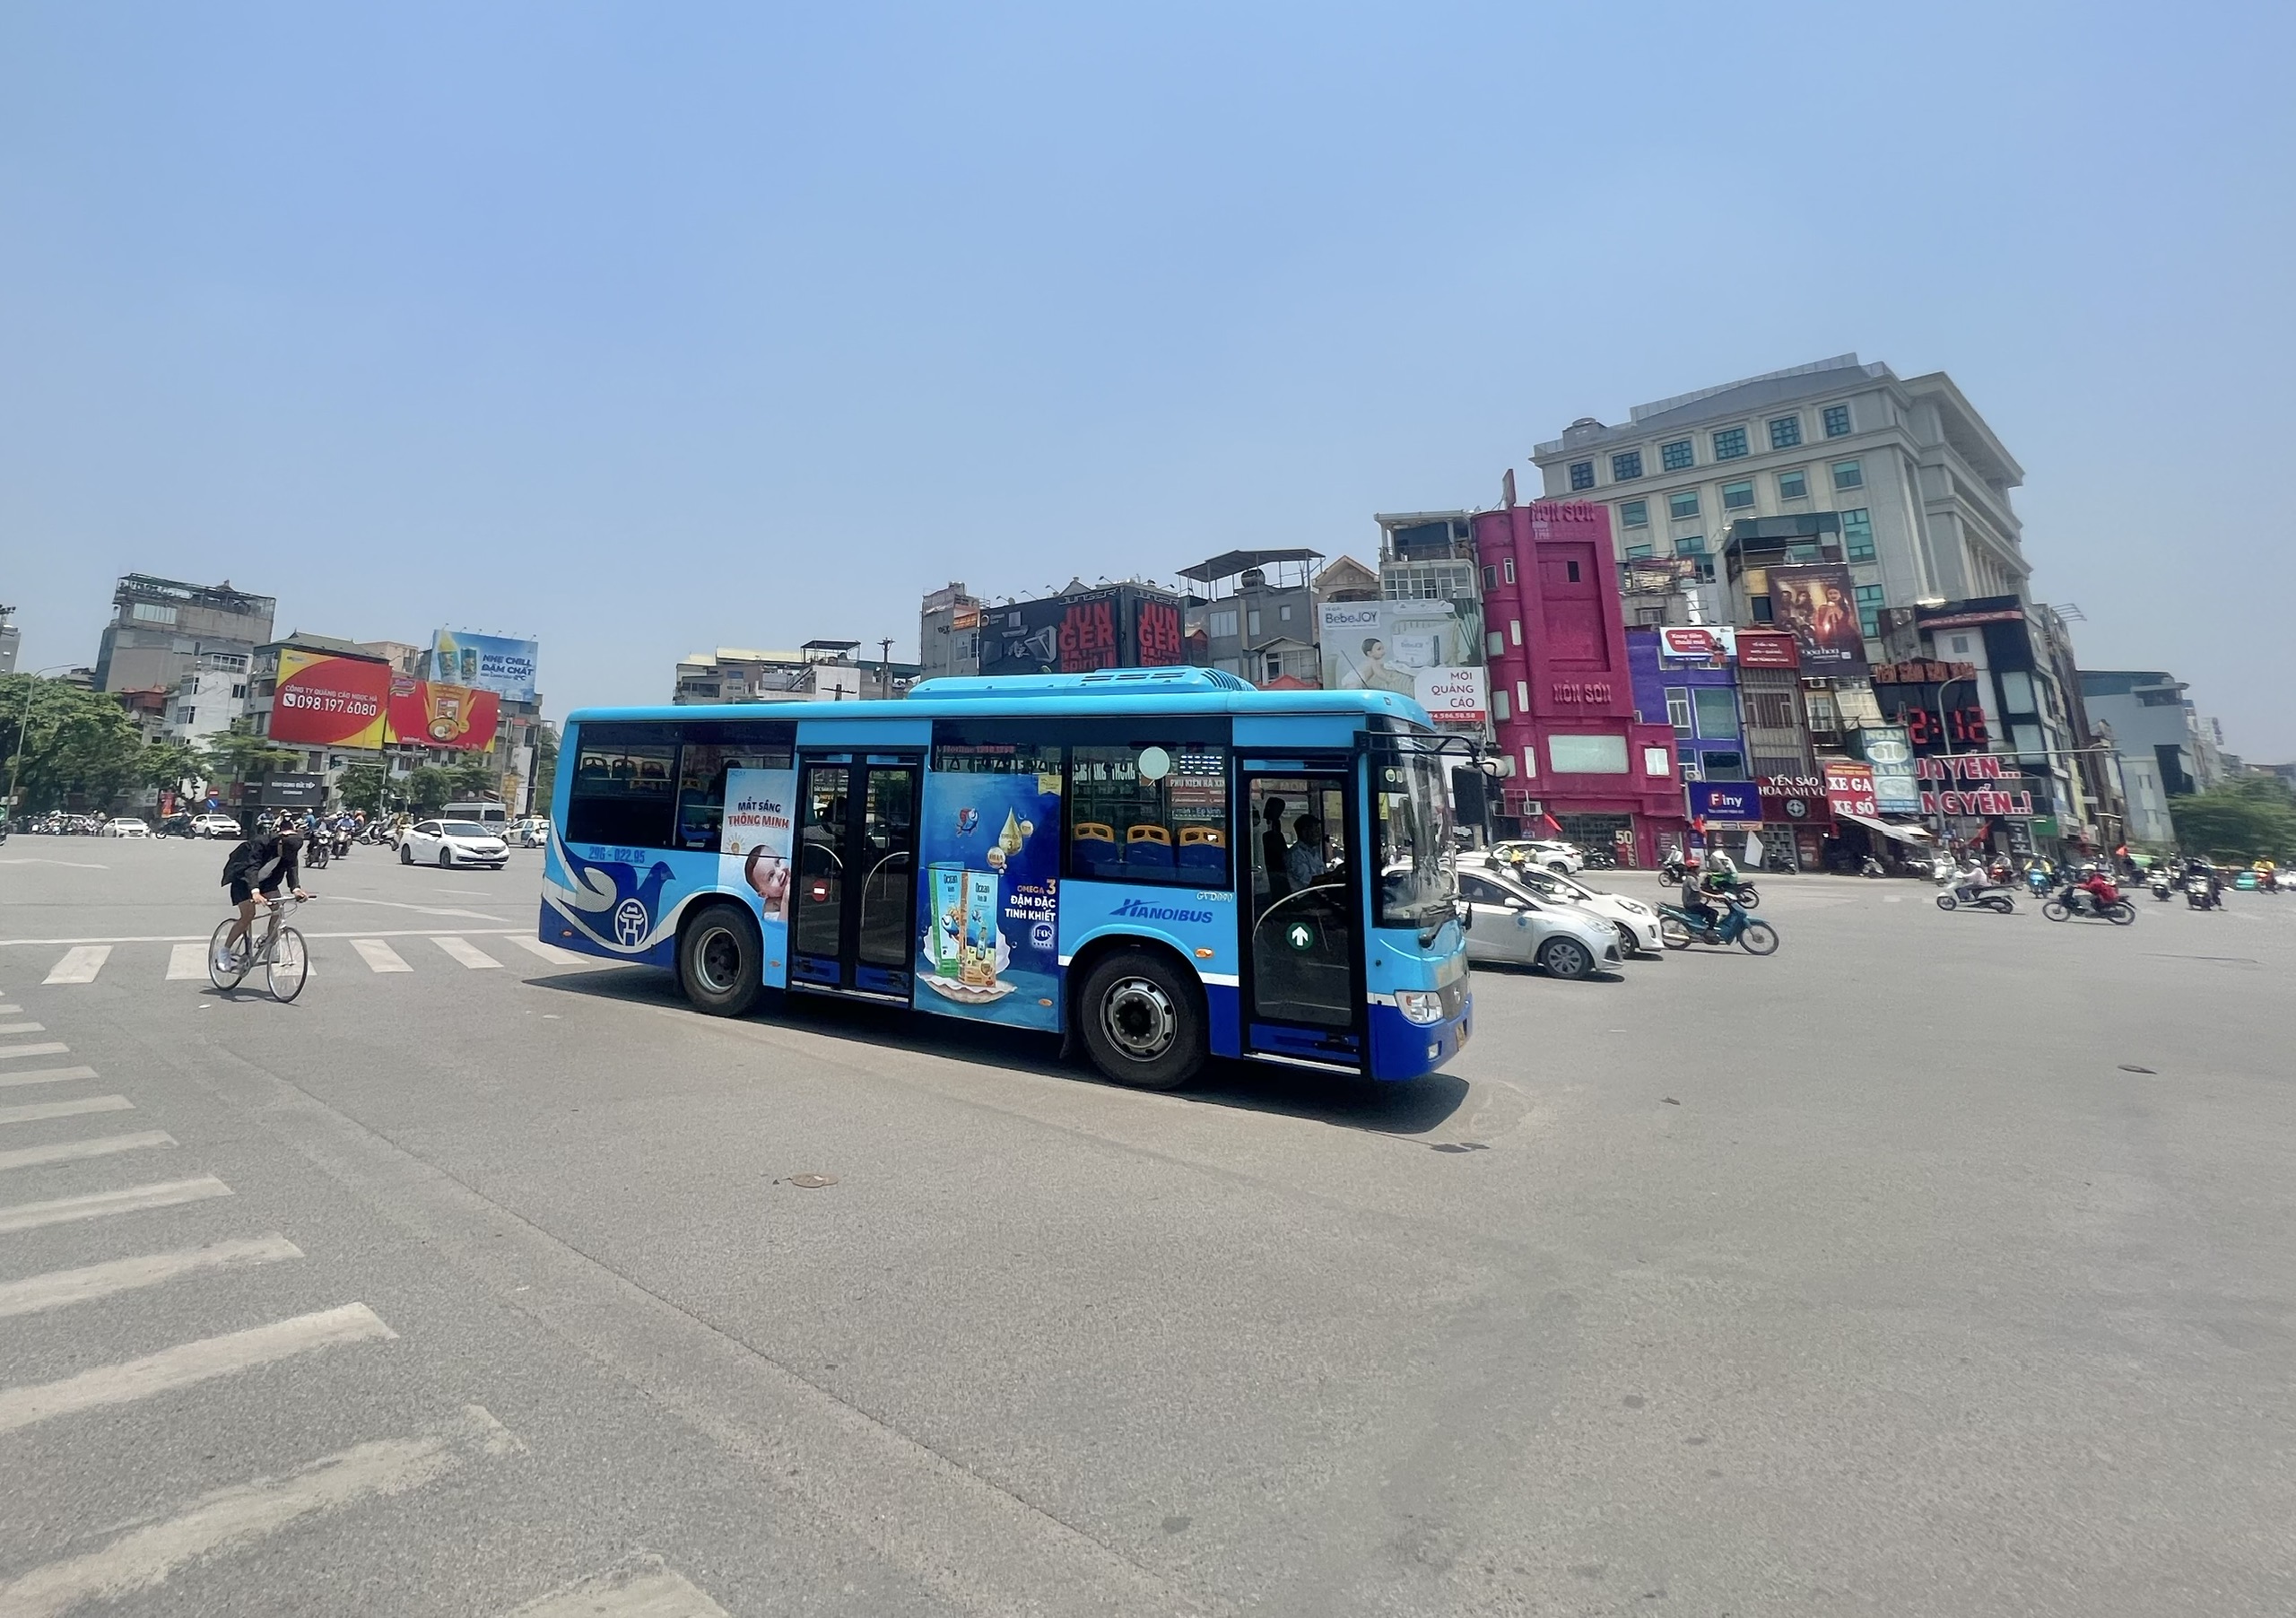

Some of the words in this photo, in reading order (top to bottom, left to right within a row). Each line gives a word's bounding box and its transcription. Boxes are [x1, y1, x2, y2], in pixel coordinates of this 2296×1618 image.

[1060, 602, 1112, 629] JUN
[1140, 604, 1178, 631] JUN
[1326, 611, 1378, 624] BebeJOY
[1059, 624, 1115, 651] GER
[1139, 625, 1180, 653] GER
[1431, 682, 1474, 696] QUẢNG
[297, 695, 377, 717] 098.197.6080
[1449, 696, 1474, 709] CÁO
[1768, 774, 1793, 787] YẾN
[1796, 774, 1819, 787] SÀO
[1827, 777, 1848, 791] XE
[1851, 778, 1874, 792] GA
[1784, 787, 1808, 796] ANH
[738, 796, 757, 812] MẮT
[758, 799, 782, 813] SÁNG
[1710, 793, 1743, 807] Finy
[1832, 800, 1854, 814] XE
[1856, 796, 1875, 815] SỐ
[727, 813, 761, 827] THÔNG
[761, 815, 790, 829] MINH
[1615, 830, 1632, 845] 50
[1017, 884, 1045, 894] OMEGA
[1046, 878, 1057, 895] 3
[1010, 893, 1032, 908] ĐẬM
[1034, 895, 1057, 909] ĐẶC
[1004, 908, 1027, 919] TINH
[1028, 909, 1057, 922] KHIẾT
[1109, 898, 1213, 924] HANOIBUS
